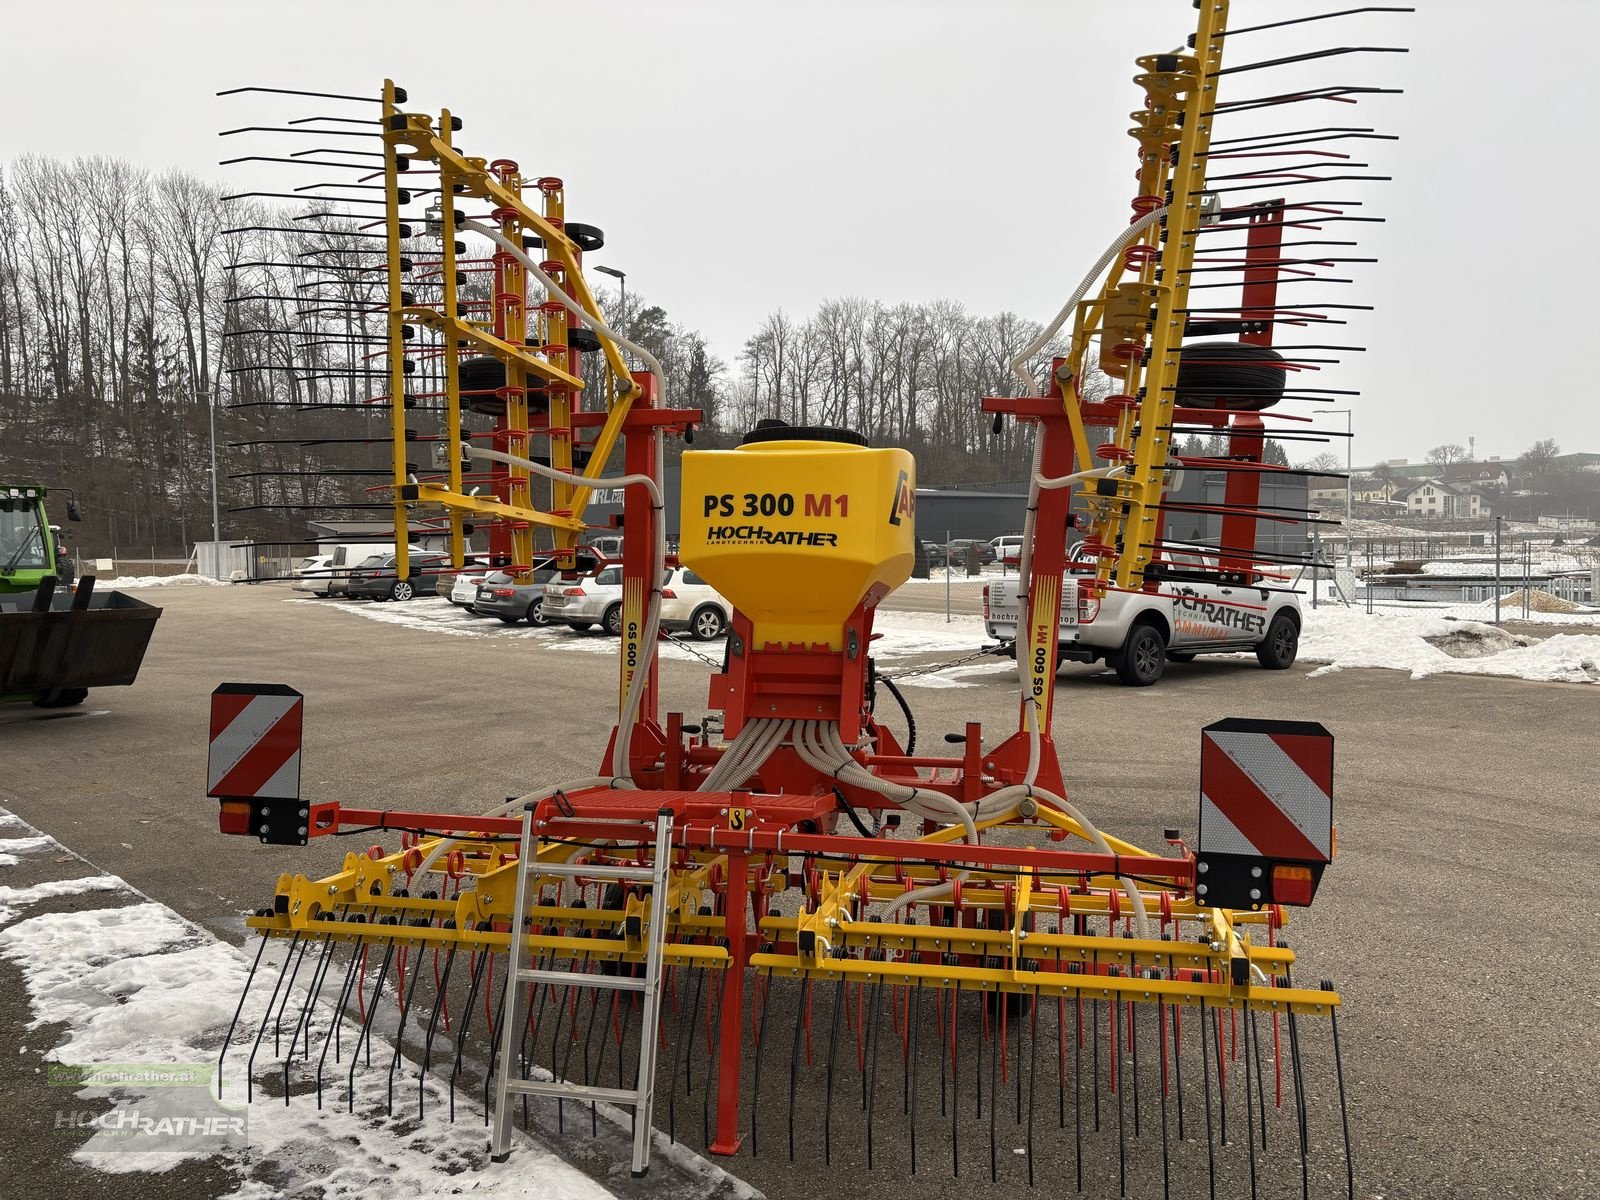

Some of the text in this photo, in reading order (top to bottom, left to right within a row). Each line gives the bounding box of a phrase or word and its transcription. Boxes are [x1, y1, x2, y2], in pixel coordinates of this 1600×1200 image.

[703, 493, 849, 518] PS 300 M1
[707, 525, 838, 547] HOCHRATHER
[627, 622, 637, 639] GS
[1037, 624, 1049, 644] M1
[627, 642, 637, 666] 600
[1034, 647, 1046, 673] 600
[1033, 677, 1044, 696] GS
